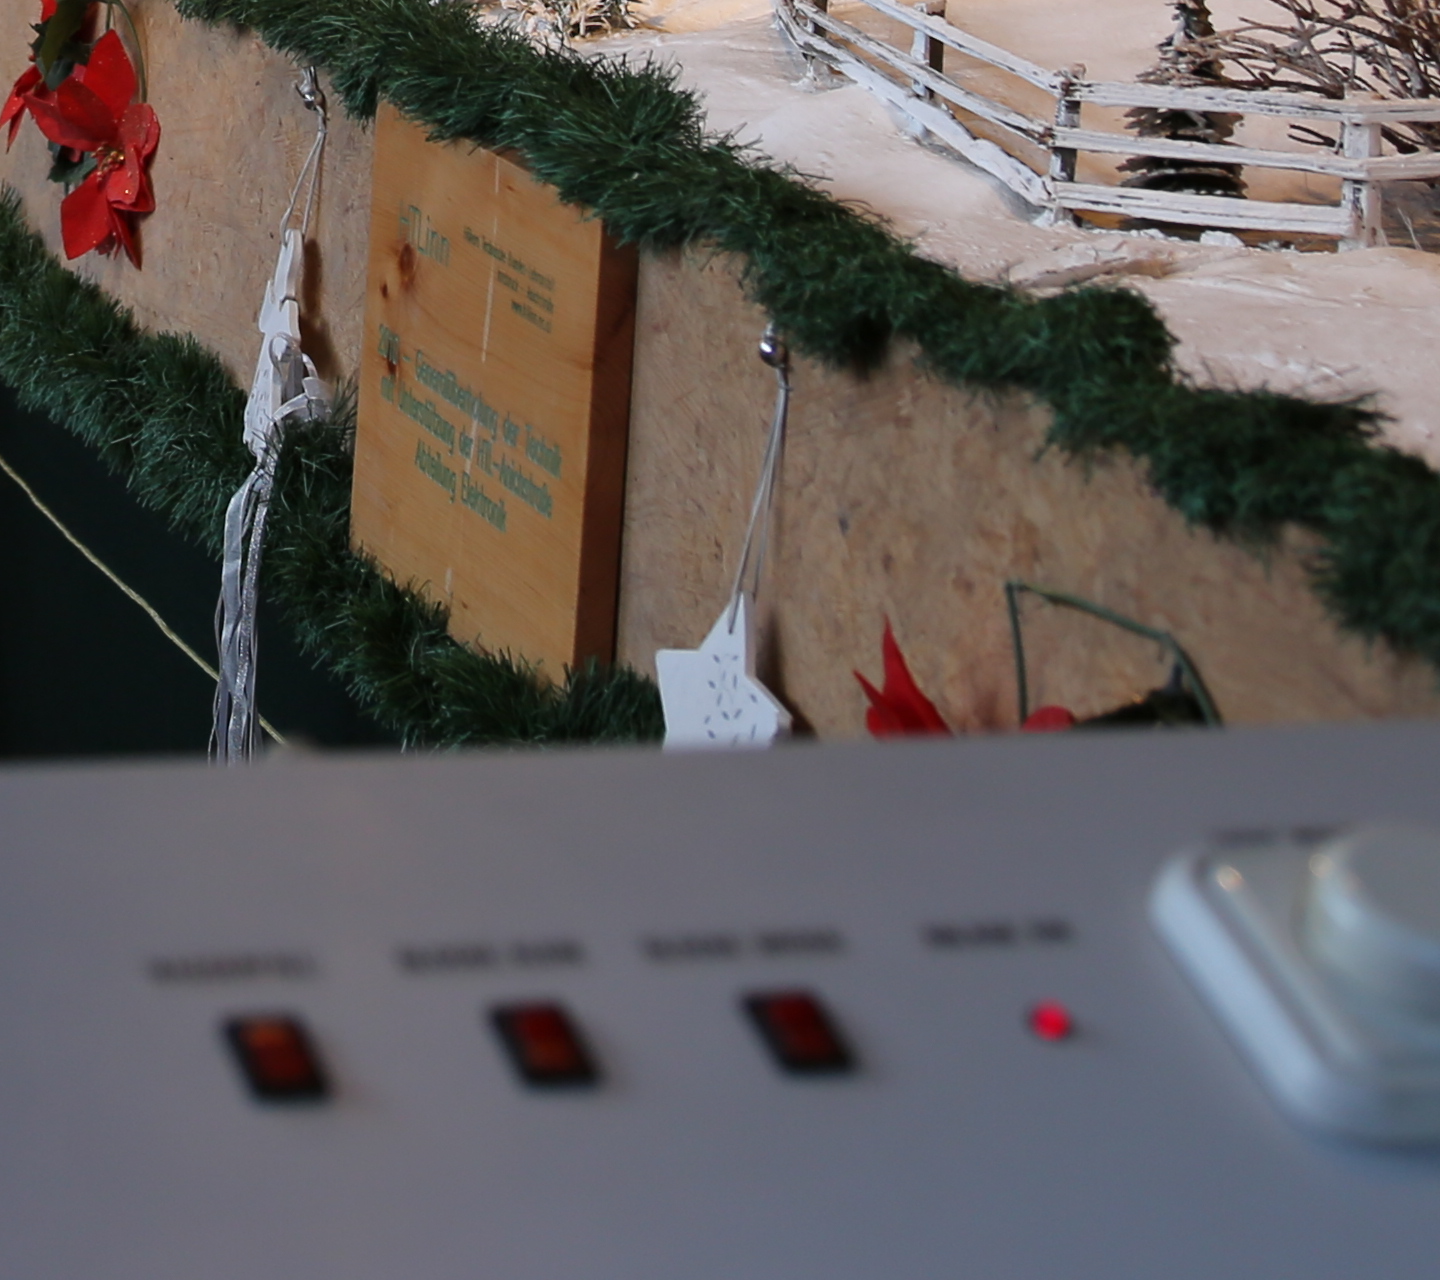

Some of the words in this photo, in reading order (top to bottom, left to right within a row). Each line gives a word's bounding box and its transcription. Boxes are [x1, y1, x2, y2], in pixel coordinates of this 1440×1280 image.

[398, 200, 450, 268] HTLinn
[398, 381, 456, 456] Unterstützung
[459, 425, 474, 460] der
[415, 349, 499, 443] Generalüberholung
[503, 411, 520, 448] der
[525, 424, 562, 480] Technik
[415, 438, 457, 504] Abteilung
[461, 470, 507, 533] Elektronik
